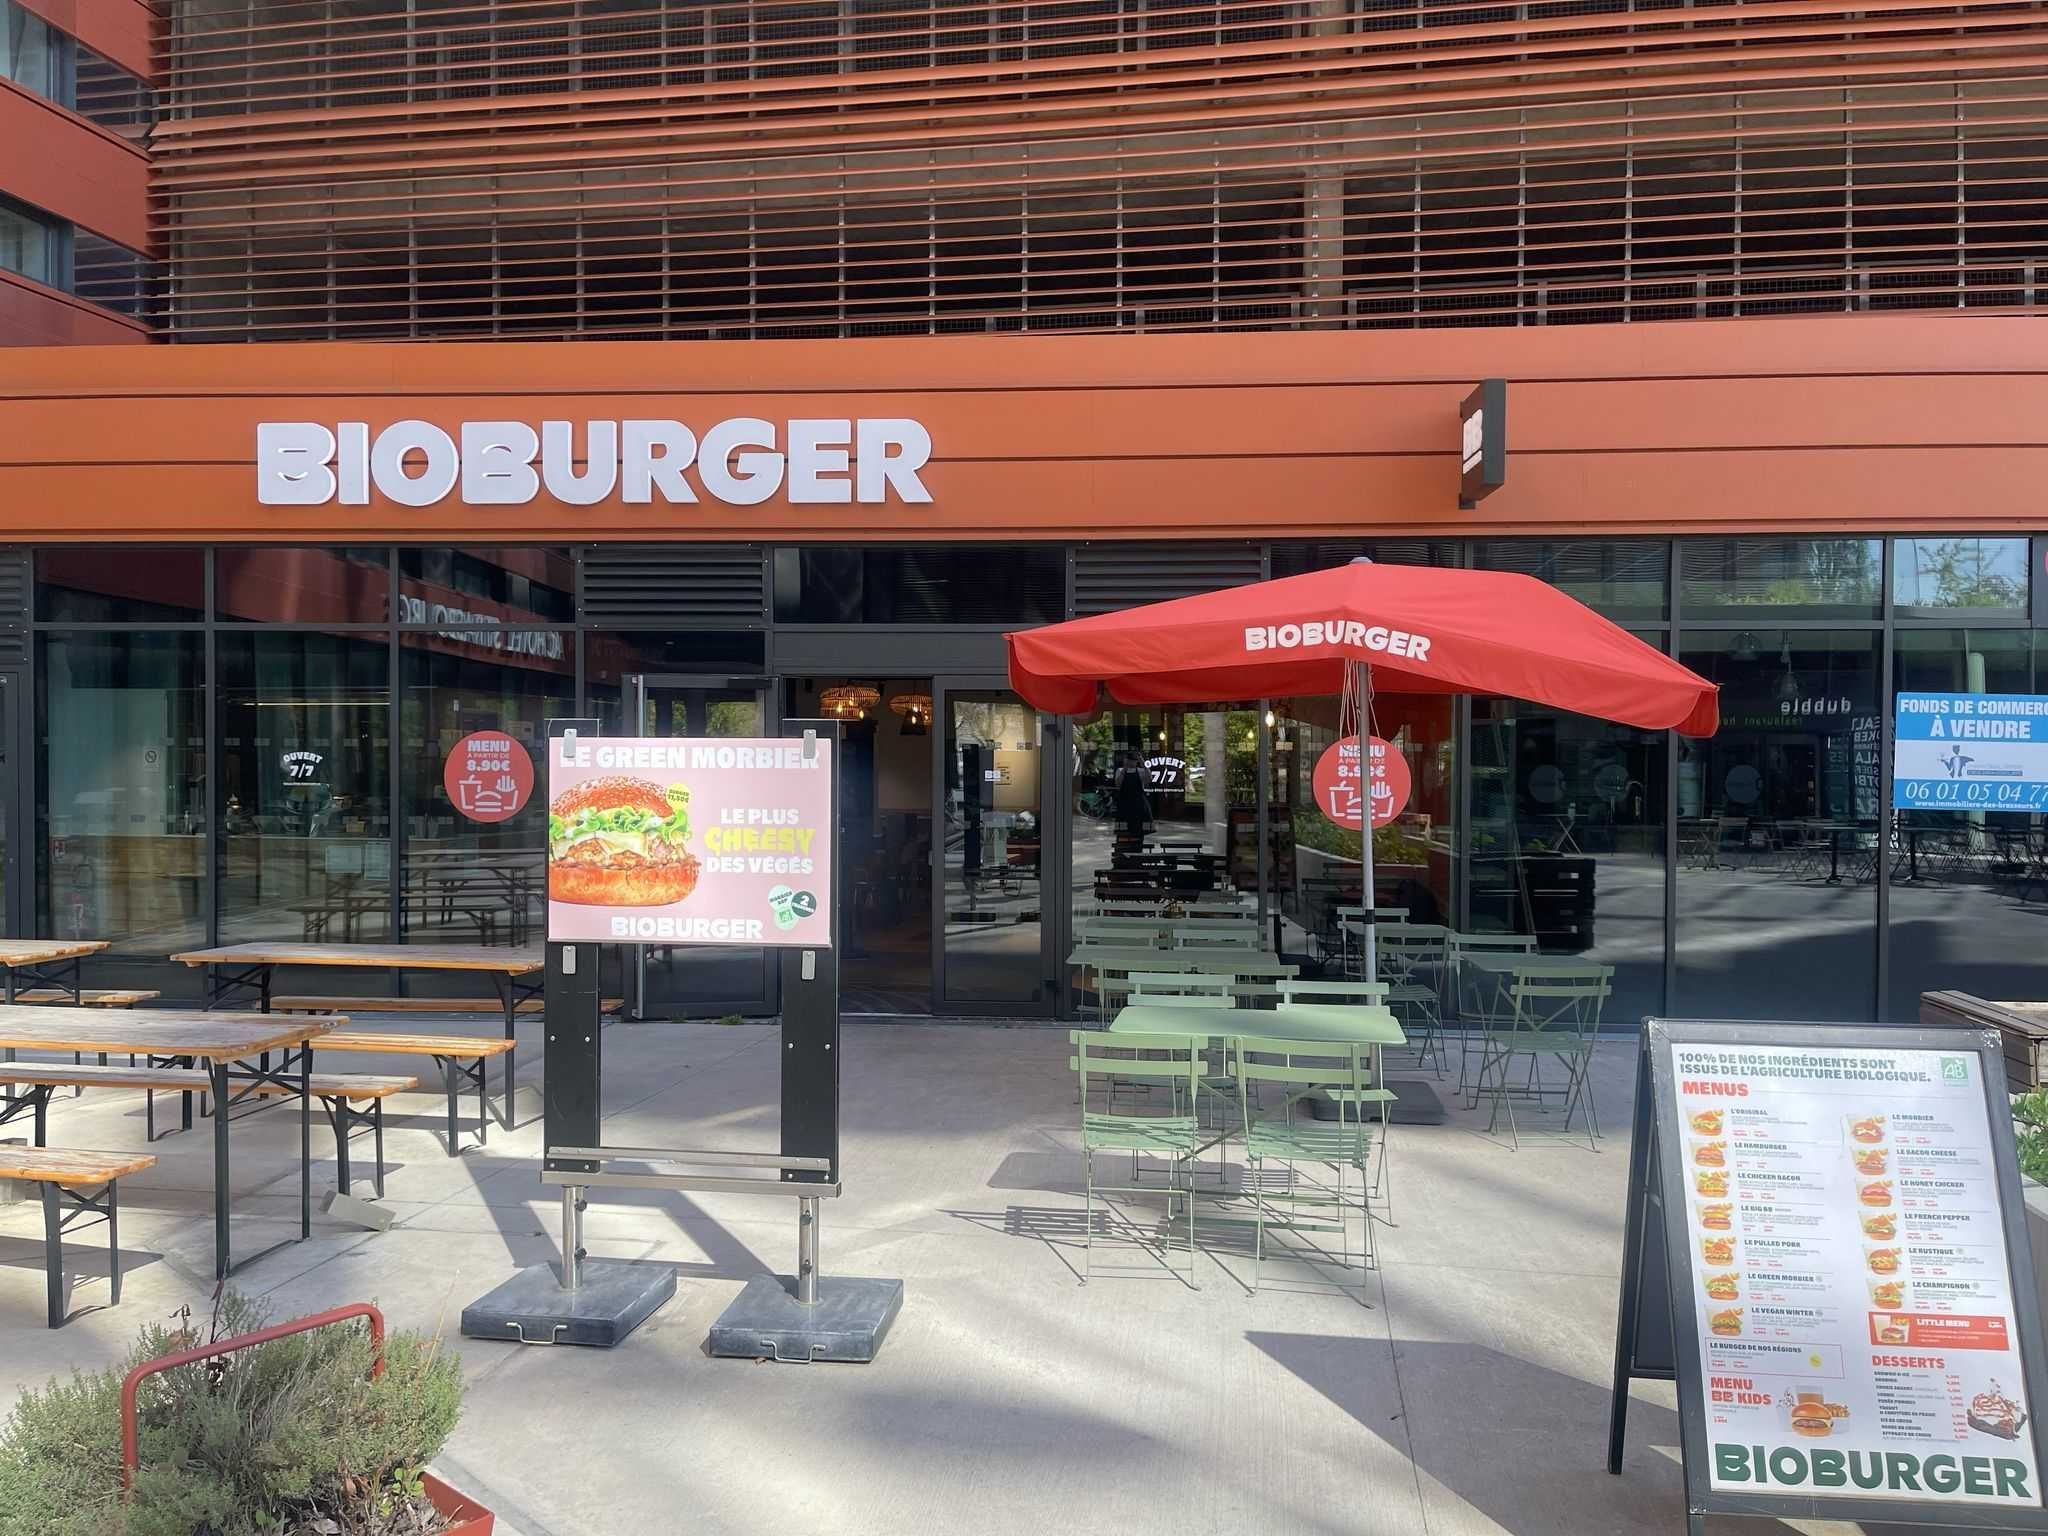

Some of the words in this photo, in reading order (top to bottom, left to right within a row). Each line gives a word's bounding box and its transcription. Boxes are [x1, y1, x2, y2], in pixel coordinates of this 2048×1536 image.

[257, 417, 935, 506] BIOBURGER
[1245, 620, 1431, 662] BIOBURGER
[1901, 699, 1949, 713] FONDS
[1955, 700, 1973, 714] DE
[1930, 715, 1945, 737] À
[1950, 719, 2031, 739] VENDRE
[468, 740, 510, 752] MENU
[1339, 745, 1385, 757] MEU
[283, 751, 323, 763] OUVERT
[559, 747, 591, 767] LE
[596, 747, 686, 768] GREEN
[1144, 757, 1186, 768] OUVERT
[290, 763, 314, 778] 7/7
[467, 760, 510, 771] 8.90€
[1151, 768, 1176, 784] 7/7
[1905, 782, 1931, 800] 06
[1936, 783, 1961, 800] 01
[1967, 783, 1992, 801] 05
[1998, 784, 2021, 801] 04
[721, 809, 746, 825] LE
[748, 809, 799, 825] PLUS
[704, 827, 816, 855] CHEESY
[707, 856, 745, 873] DES
[800, 895, 810, 906] 2
[611, 917, 763, 938] BIOBURGER
[1679, 1053, 1716, 1063] 100%
[1718, 1054, 1736, 1064] DE
[1738, 1055, 1766, 1065] NOS
[1769, 1055, 1857, 1068] INGRÉDIENTS
[1861, 1059, 1896, 1069] SONT
[1680, 1064, 1718, 1074] ISSUS
[1721, 1065, 1739, 1075] DE
[1741, 1066, 1842, 1079] L'AGRICULTURE
[1844, 1070, 1931, 1082] BIOLOGIQUE.
[1682, 1081, 1749, 1096] MENUS
[1946, 1320, 1970, 1328] MENU
[1872, 1355, 1945, 1369] DESSERTS
[1711, 1376, 1753, 1390] MENU
[1712, 1390, 1734, 1402] BE
[1738, 1392, 1772, 1405] KIDS
[1714, 1443, 2032, 1498] BIOBURGER
